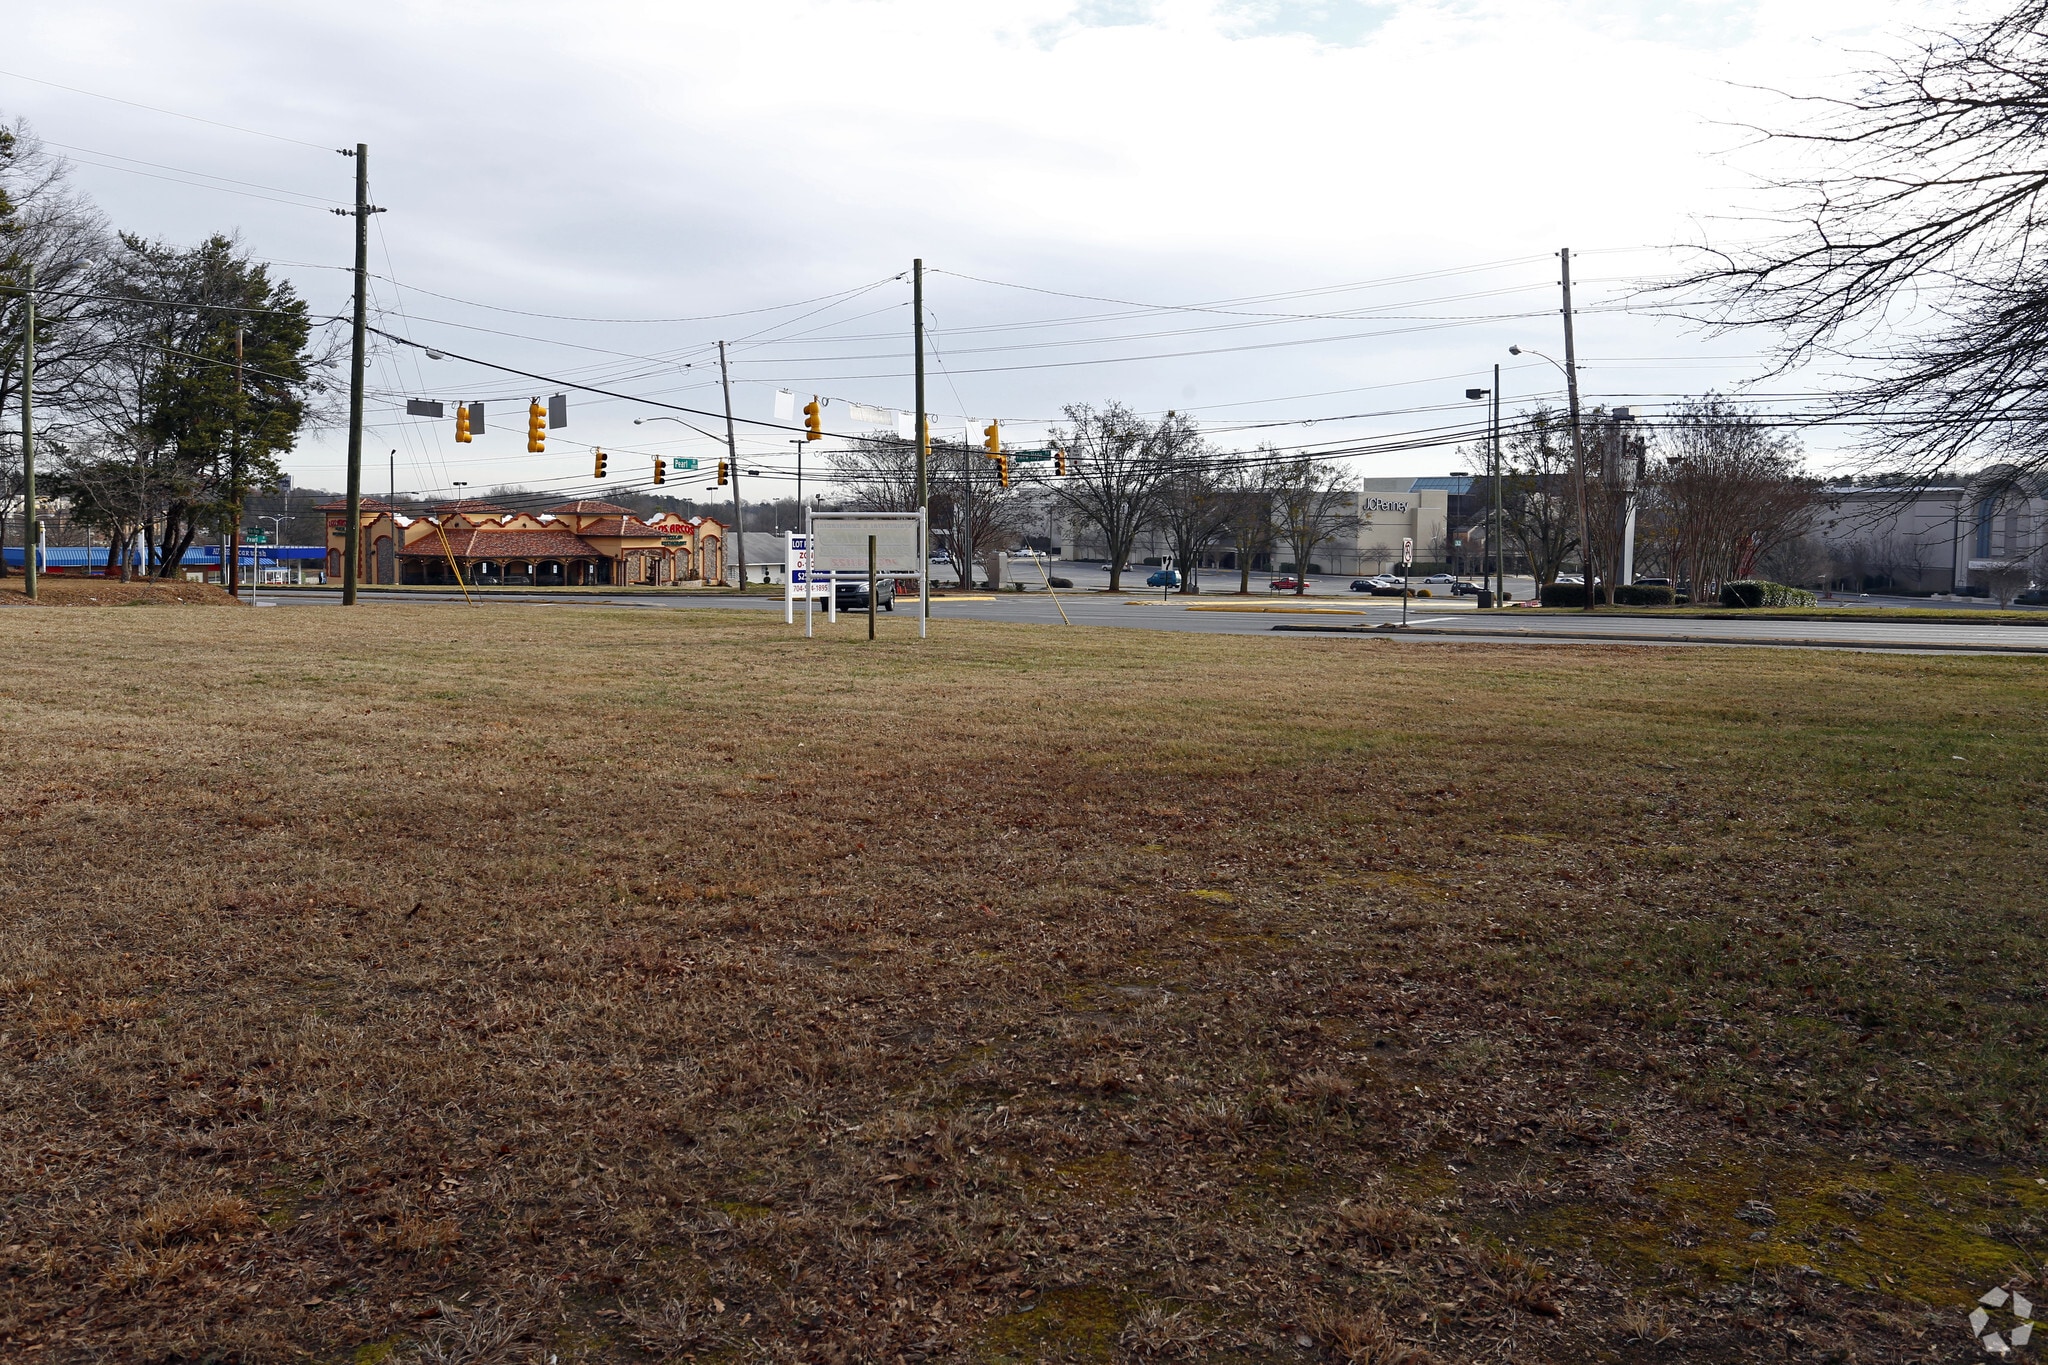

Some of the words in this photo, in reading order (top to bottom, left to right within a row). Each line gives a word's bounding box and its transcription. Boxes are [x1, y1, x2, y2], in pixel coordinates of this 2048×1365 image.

[675, 459, 688, 469] Pearl
[1363, 498, 1409, 513] JCPenney
[670, 524, 694, 536] ARCOS
